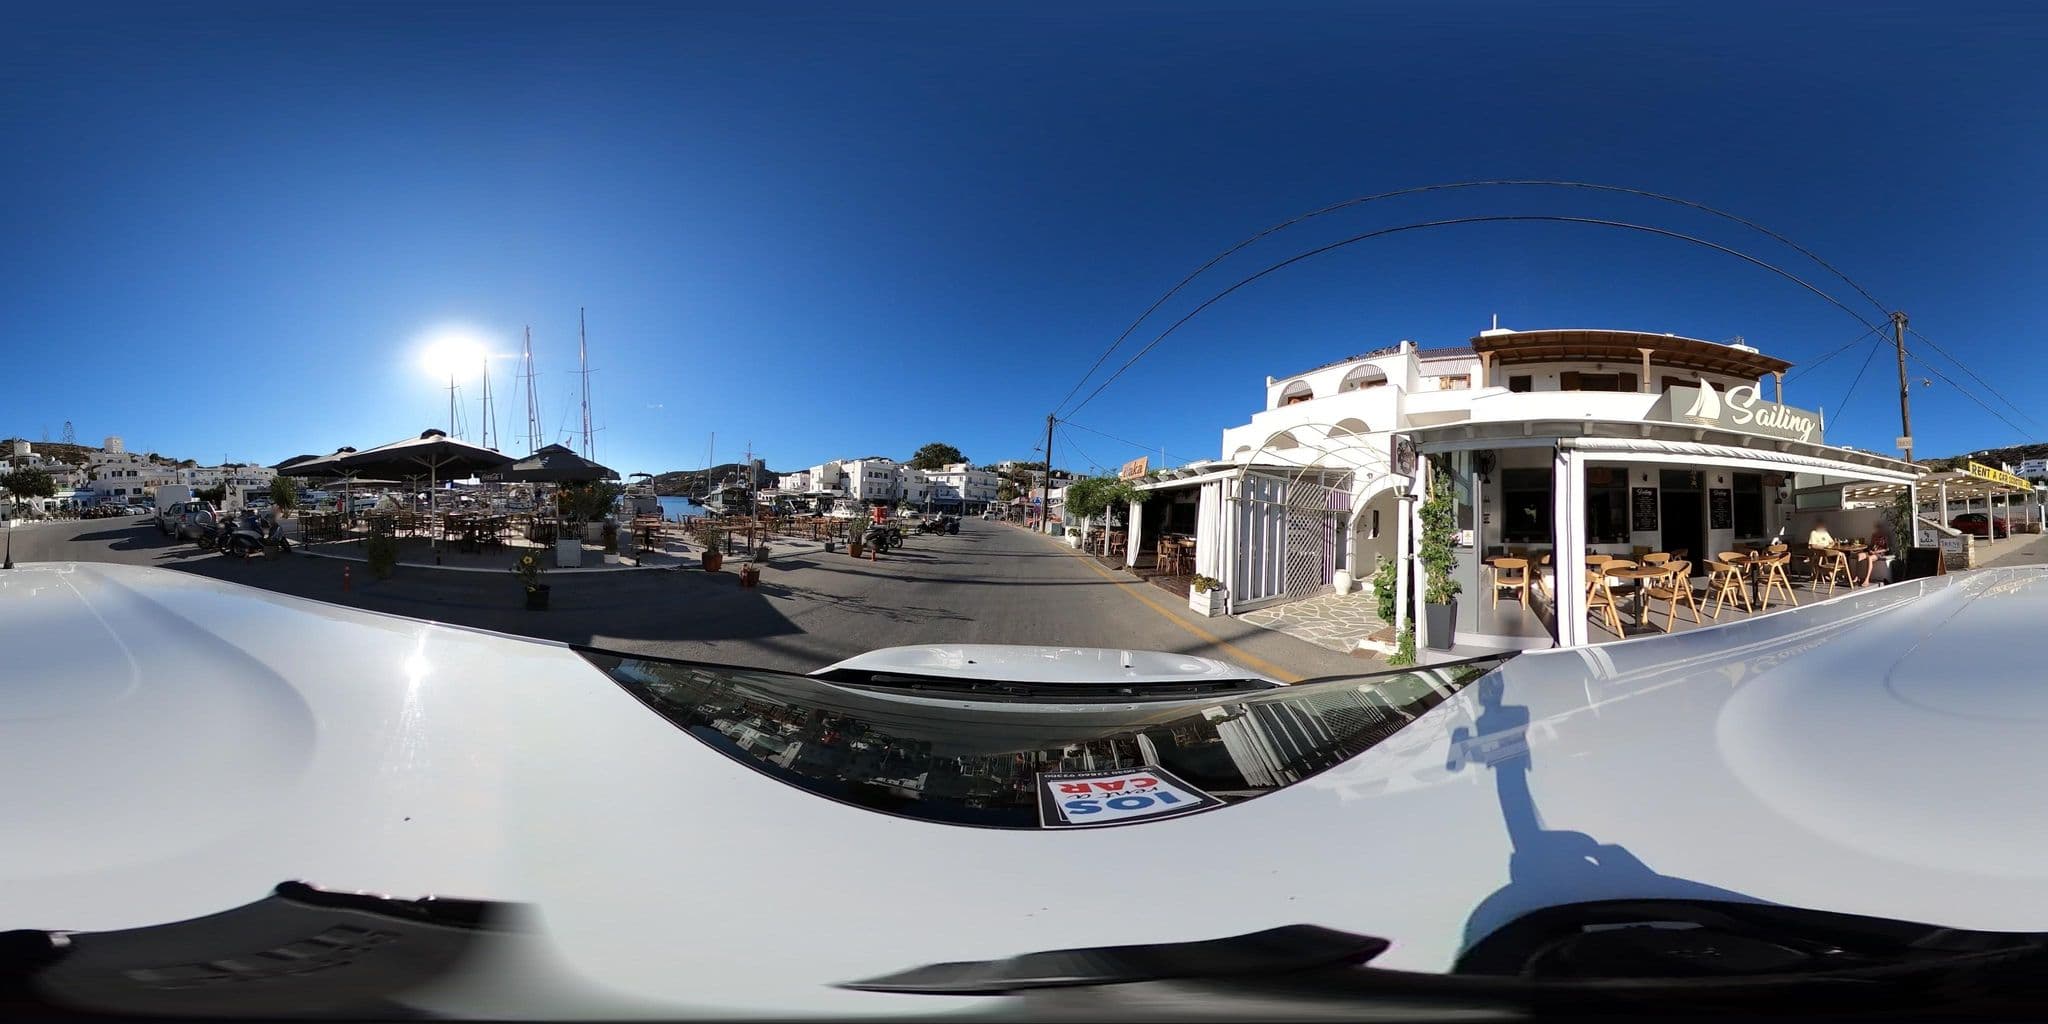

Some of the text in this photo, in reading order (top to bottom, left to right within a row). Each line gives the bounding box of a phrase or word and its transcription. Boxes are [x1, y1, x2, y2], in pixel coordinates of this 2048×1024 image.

[1725, 385, 1815, 442] Sailing
[1971, 463, 1990, 478] RENT
[1059, 778, 1159, 794] CAR
[1098, 787, 1158, 799] rent
[1064, 791, 1181, 814] IOS
